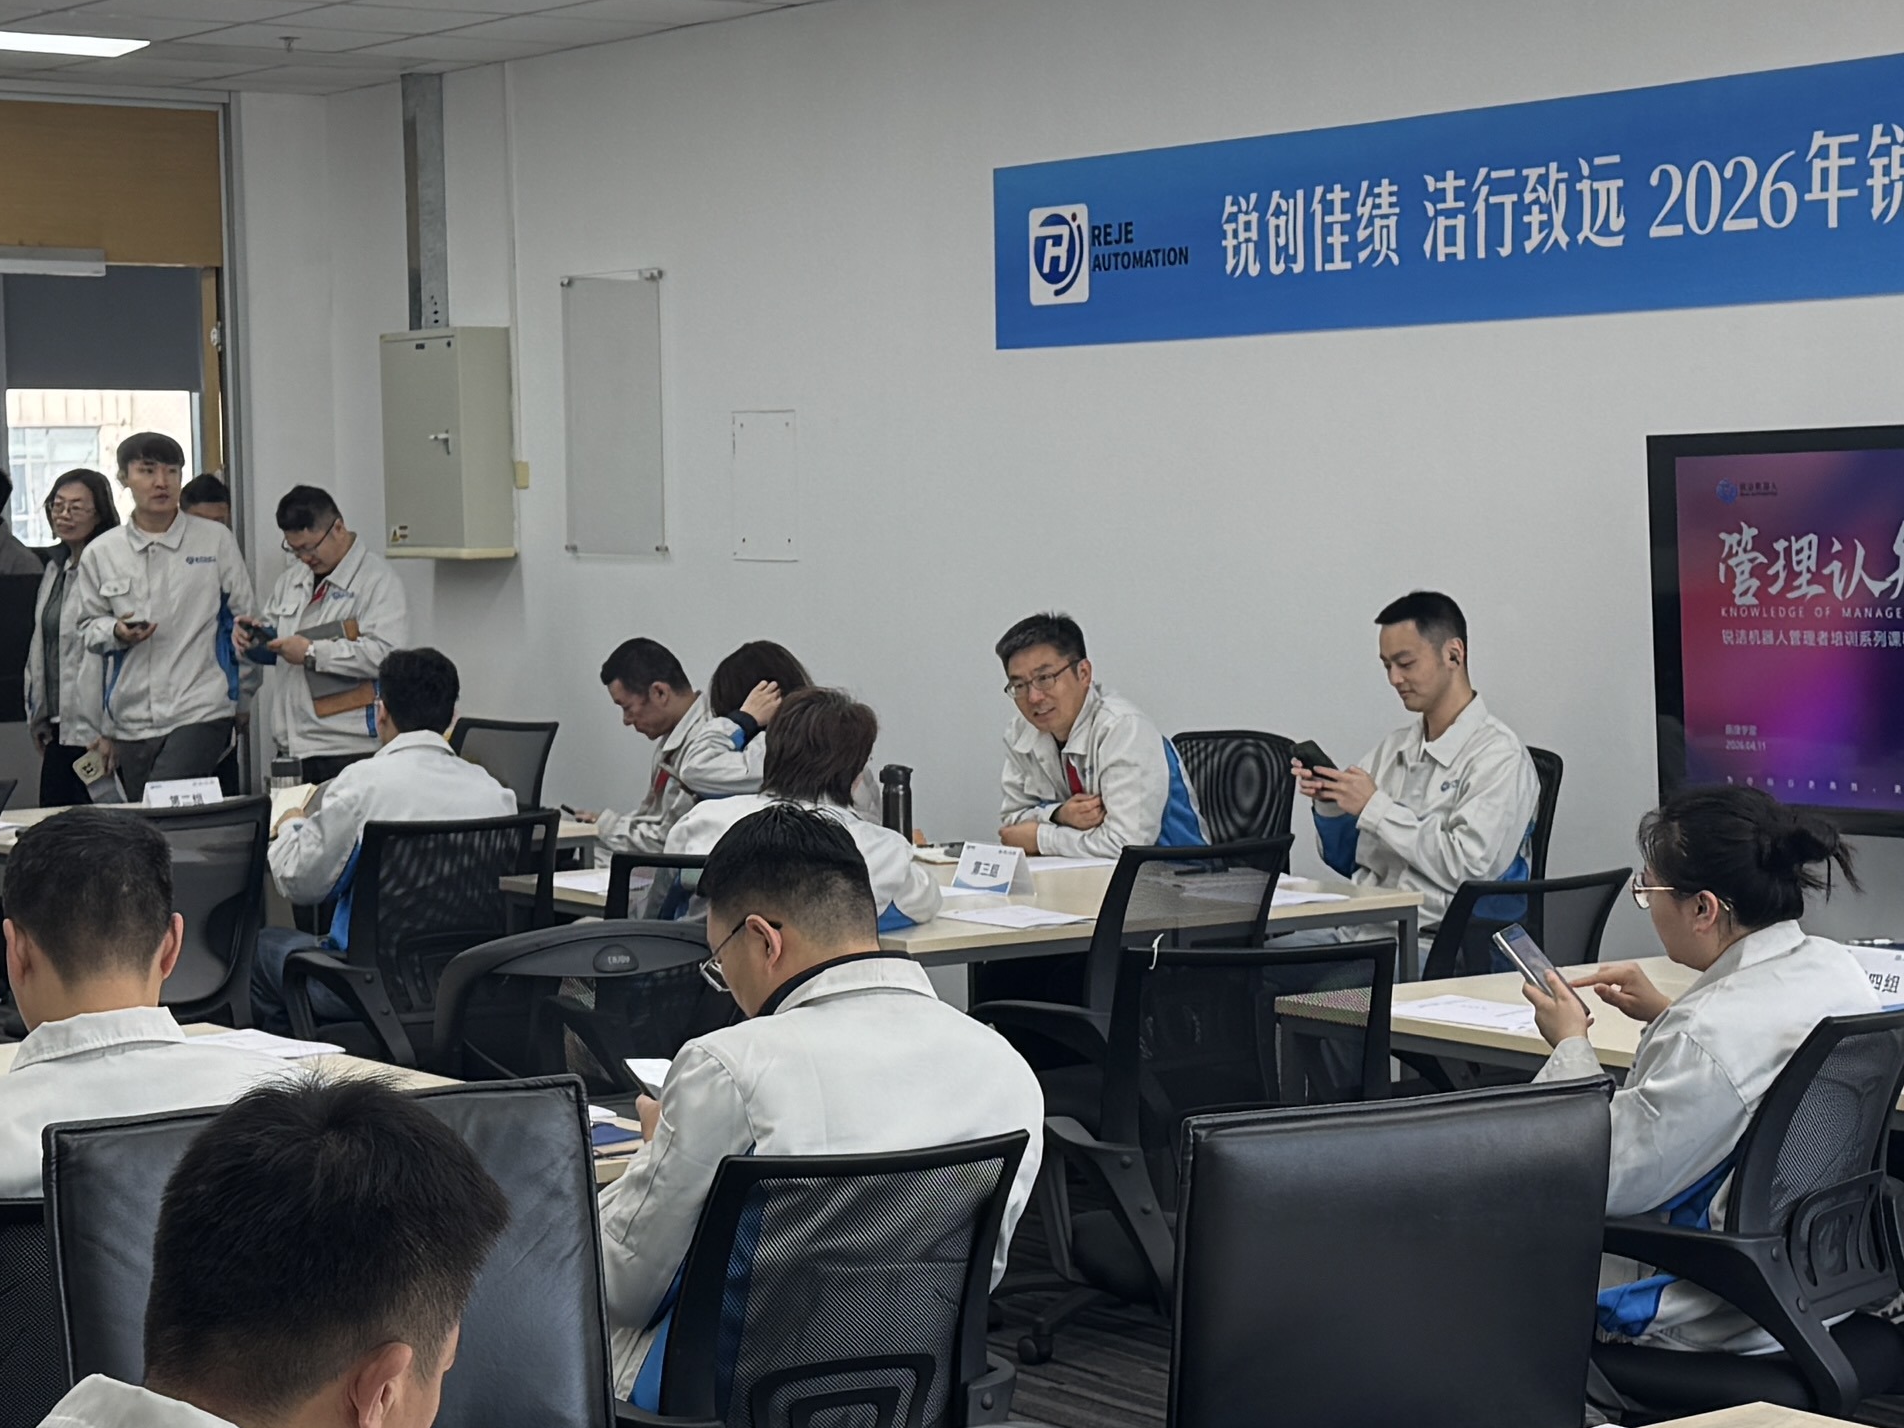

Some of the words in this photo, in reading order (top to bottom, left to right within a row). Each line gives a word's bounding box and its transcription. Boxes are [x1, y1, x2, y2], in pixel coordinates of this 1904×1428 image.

[1221, 178, 1401, 278] 锐创佳绩
[1422, 154, 1626, 263] 洁行致远
[1091, 221, 1134, 247] REJE
[1091, 246, 1189, 272] AUTOMATION
[1720, 606, 1806, 619] KNOWLEDGE
[1814, 606, 1831, 619] OF
